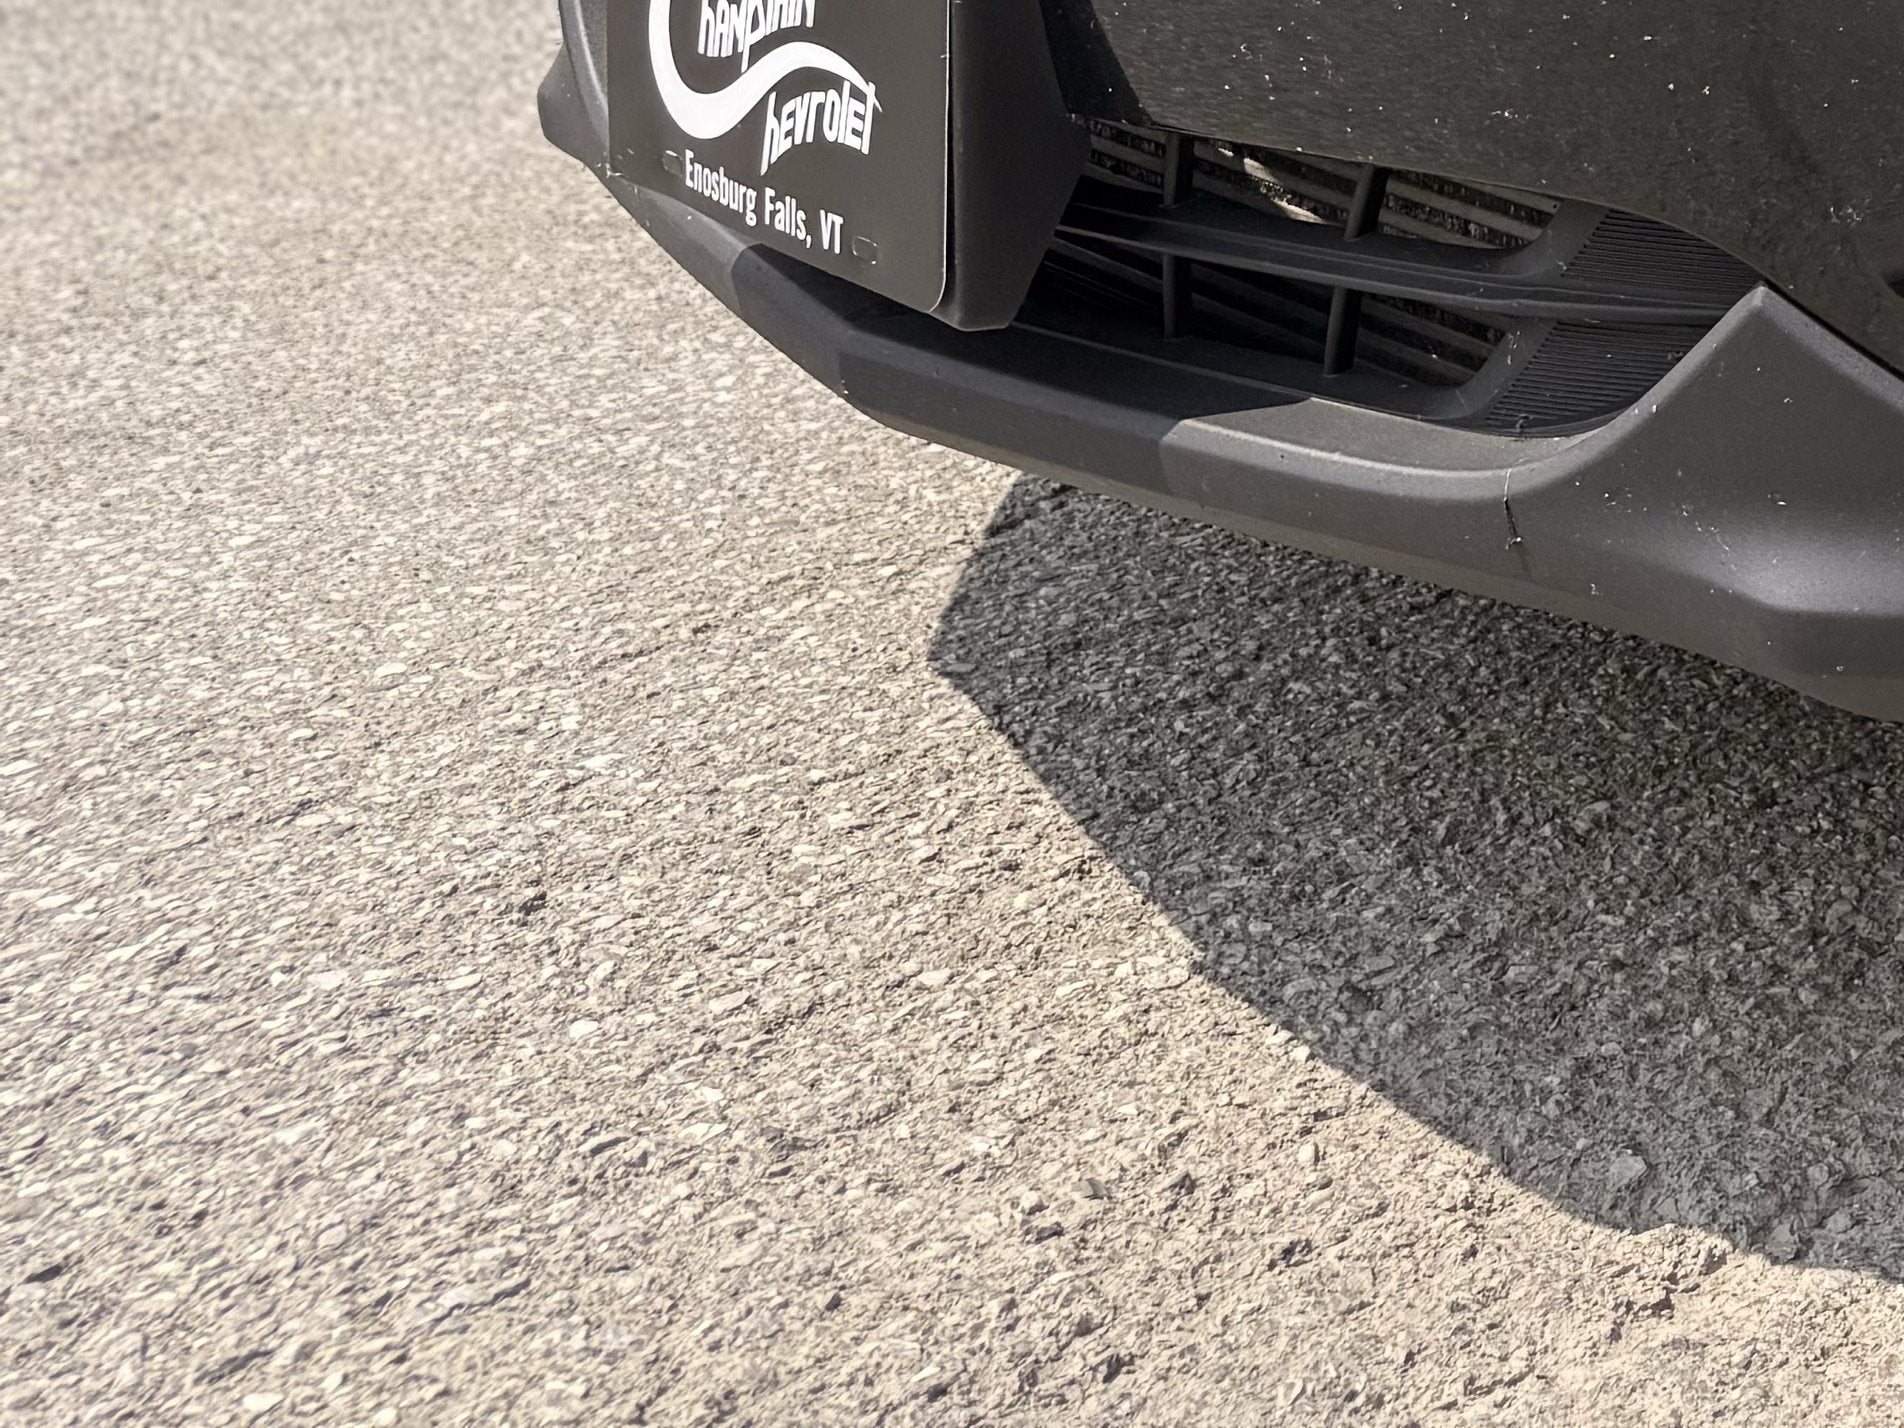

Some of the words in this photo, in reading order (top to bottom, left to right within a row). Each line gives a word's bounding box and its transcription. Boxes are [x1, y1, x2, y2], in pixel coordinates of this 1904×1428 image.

[685, 149, 758, 227] Enosburg
[765, 187, 812, 248] Falls,
[820, 209, 844, 254] VT
